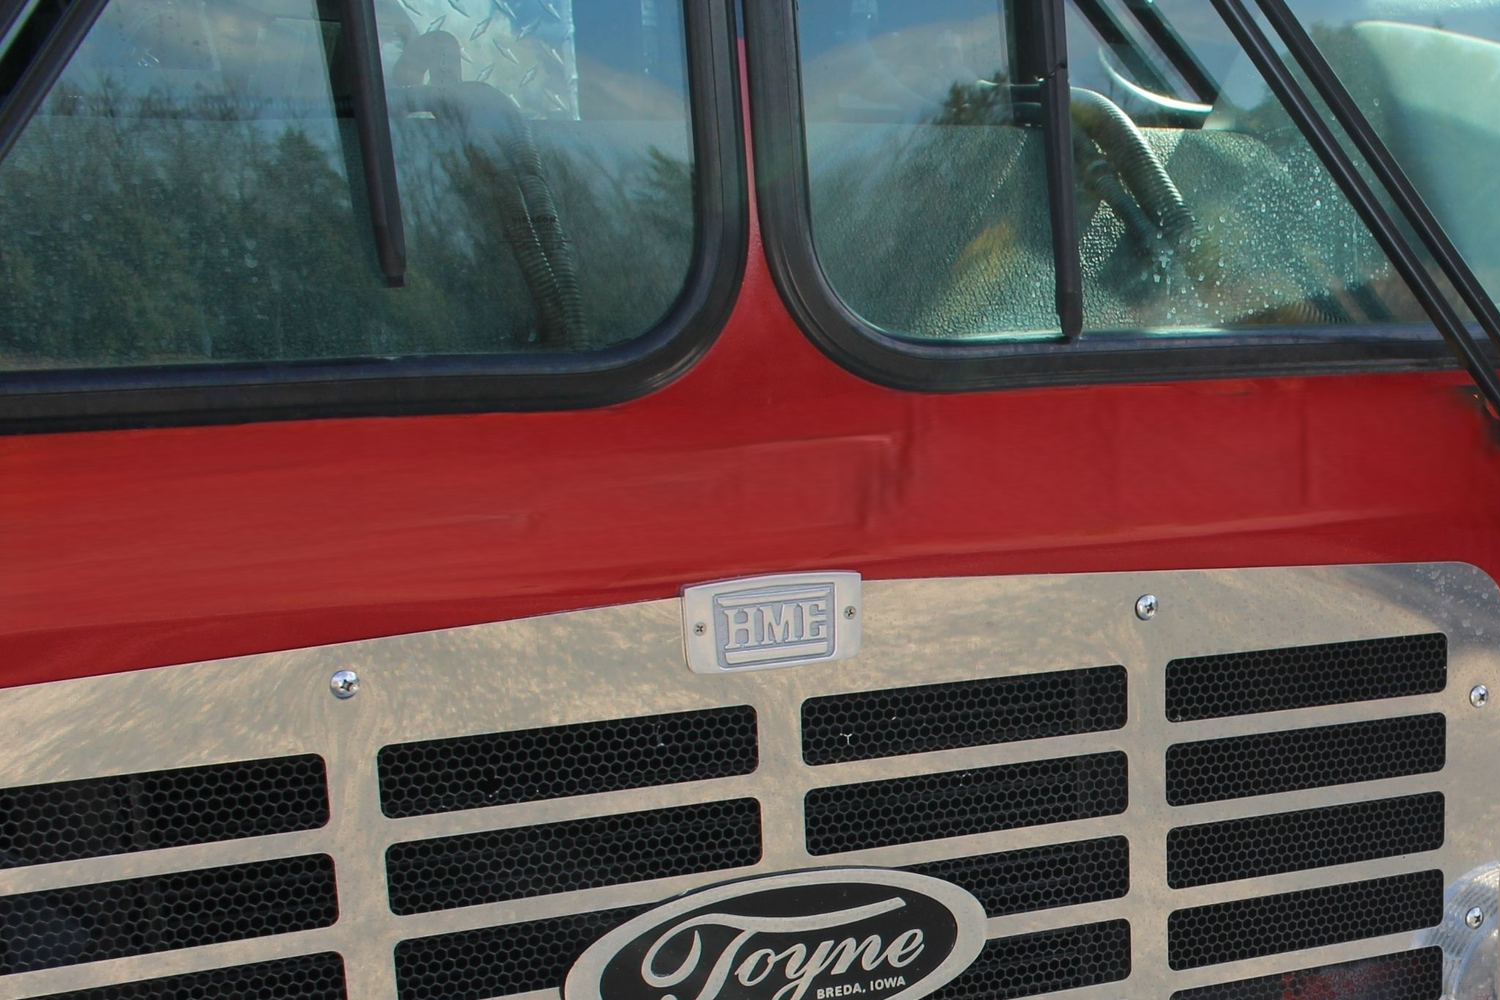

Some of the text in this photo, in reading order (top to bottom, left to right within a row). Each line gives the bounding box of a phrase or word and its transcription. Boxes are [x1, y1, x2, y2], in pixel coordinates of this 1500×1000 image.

[723, 600, 828, 650] HME
[816, 975, 907, 1000] BREDA, IOWA
